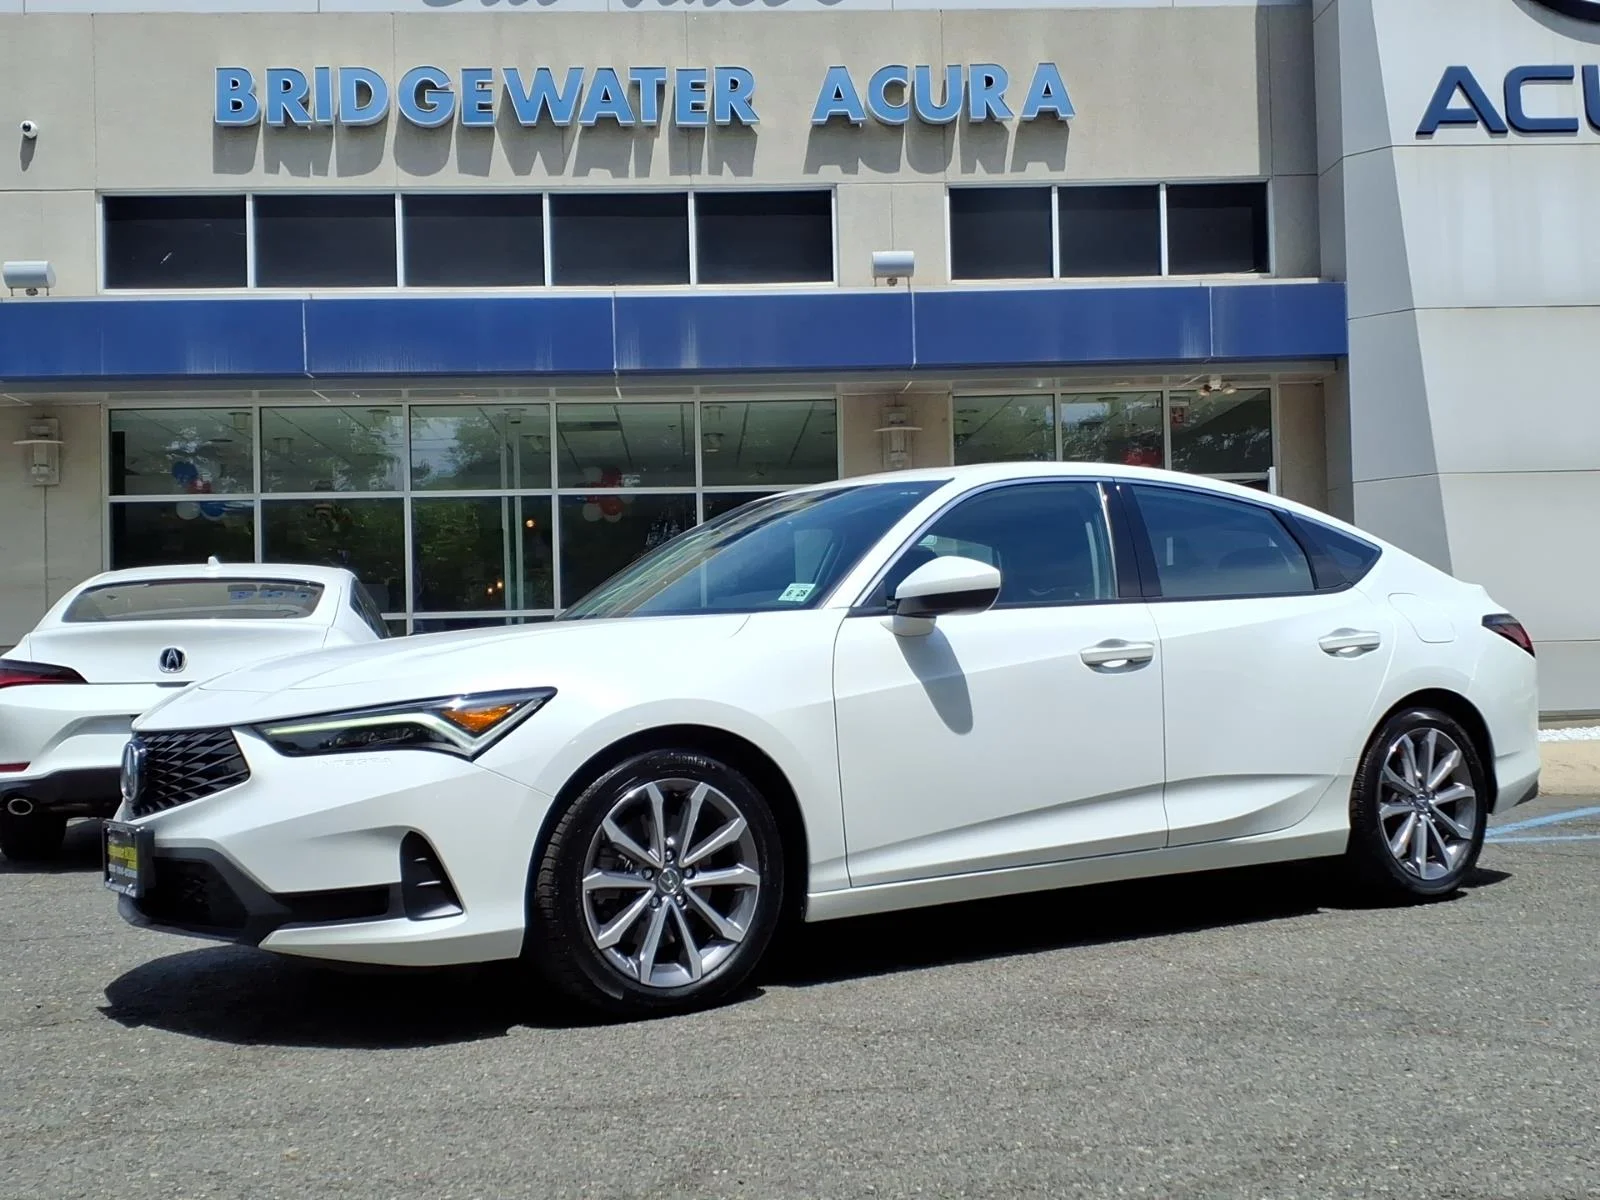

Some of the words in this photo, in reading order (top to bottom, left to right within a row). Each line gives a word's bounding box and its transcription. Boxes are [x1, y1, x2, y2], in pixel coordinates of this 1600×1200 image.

[214, 65, 760, 128] BRIDGEWATER
[811, 62, 1075, 126] ACURA
[1415, 64, 1600, 136] AC
